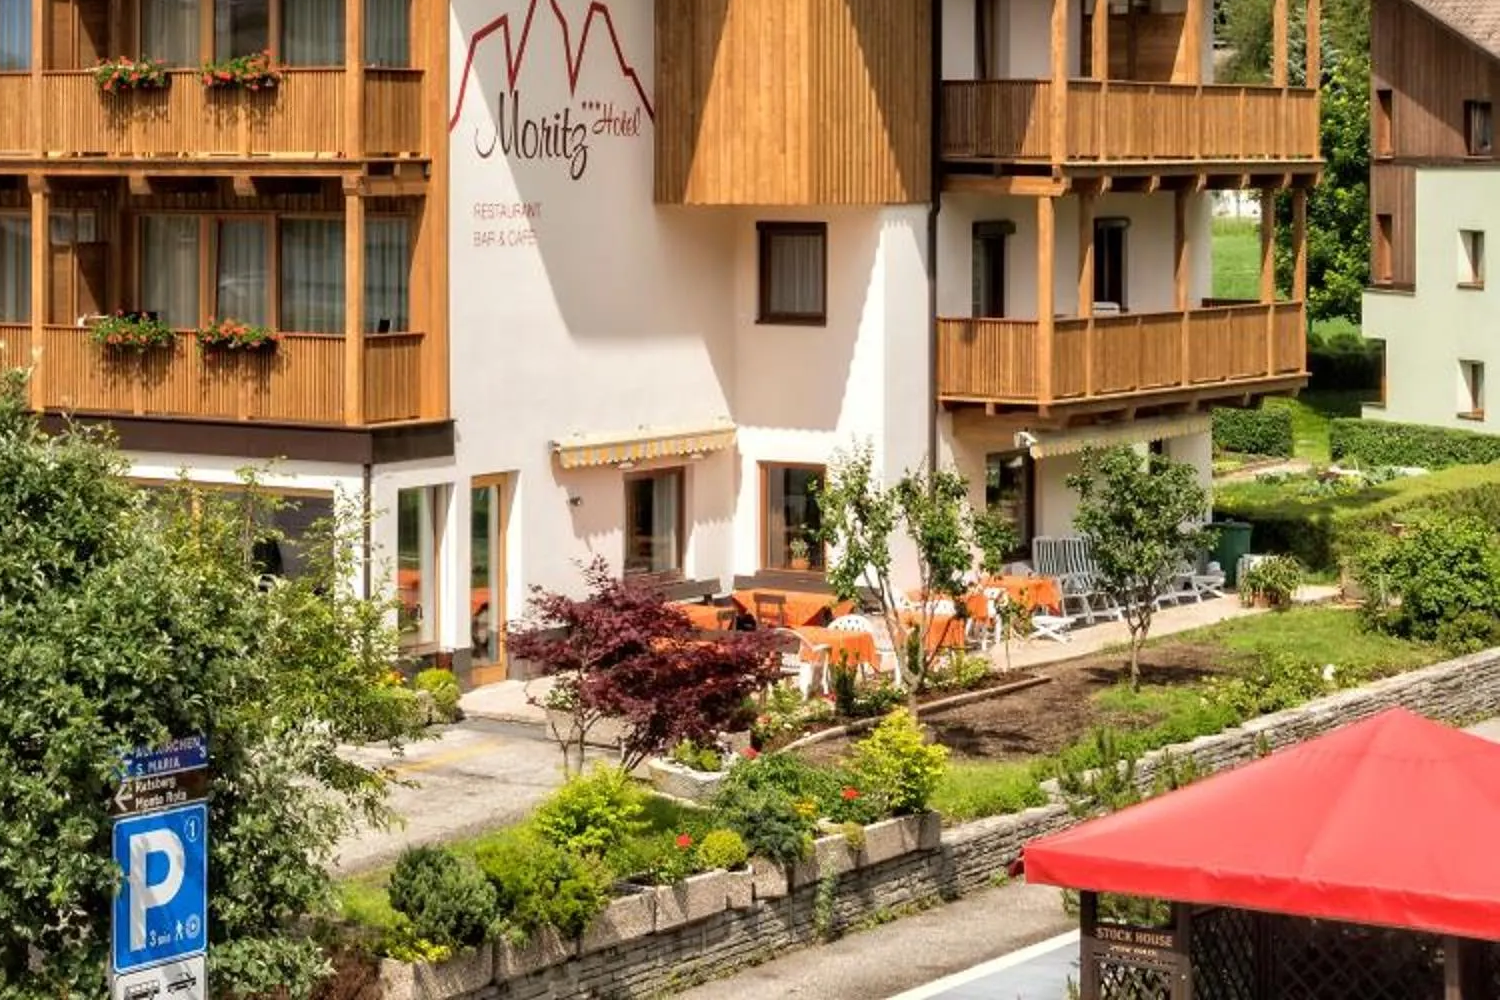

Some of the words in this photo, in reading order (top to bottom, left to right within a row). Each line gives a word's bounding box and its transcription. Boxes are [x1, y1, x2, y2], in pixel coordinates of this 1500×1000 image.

[592, 102, 641, 137] Hotel
[474, 89, 588, 180] Moritz
[473, 201, 543, 219] RESTAURANT
[473, 230, 495, 247] BAR
[147, 756, 181, 774] MARIA
[129, 828, 186, 952] P
[1134, 931, 1173, 948] HOUSE
